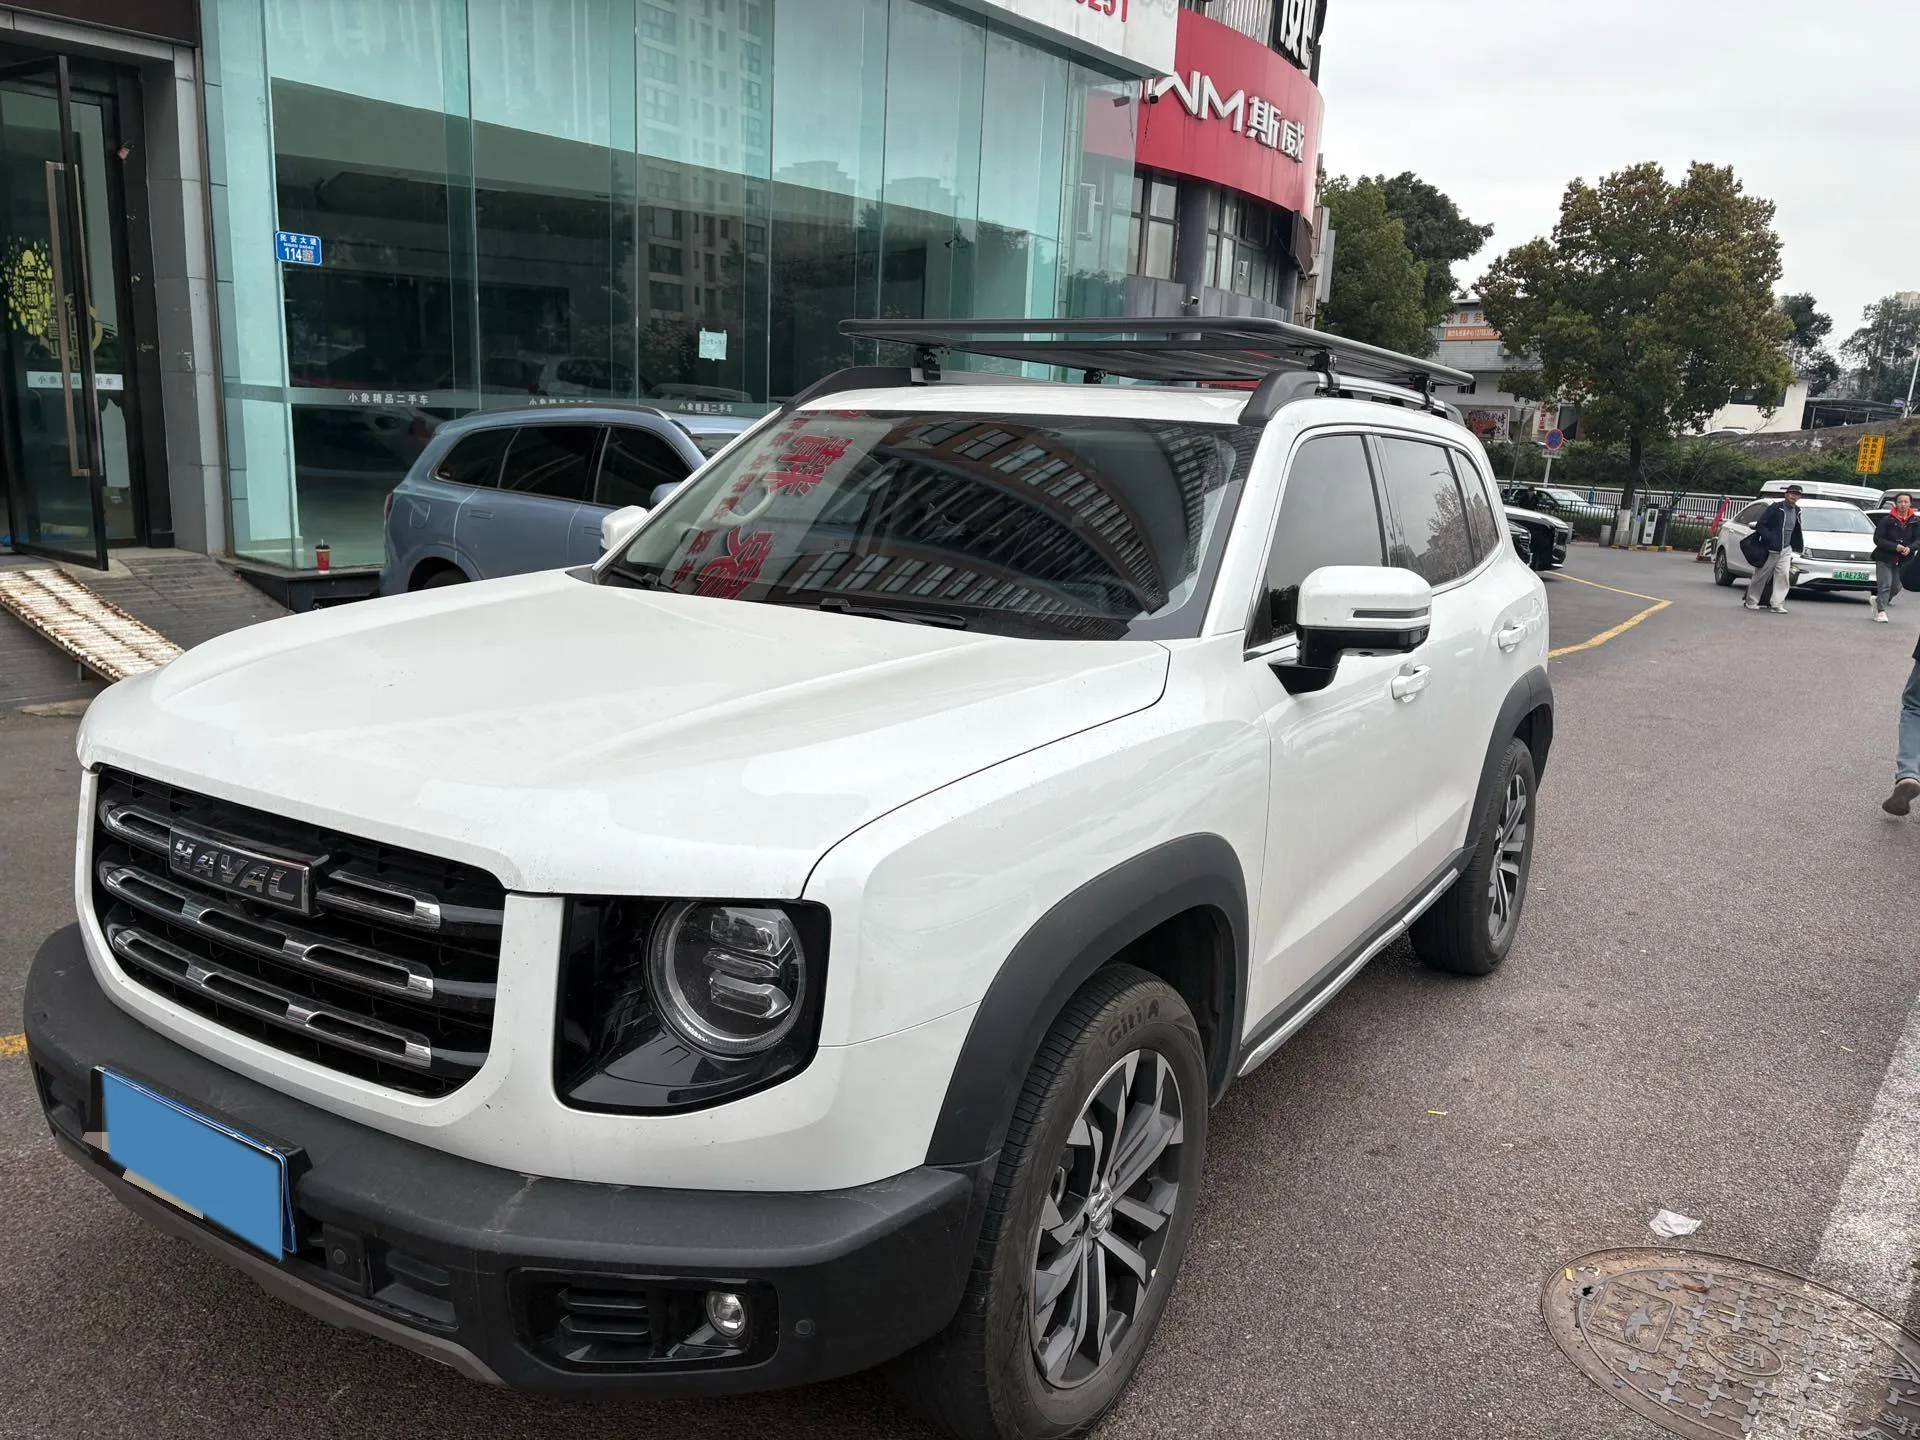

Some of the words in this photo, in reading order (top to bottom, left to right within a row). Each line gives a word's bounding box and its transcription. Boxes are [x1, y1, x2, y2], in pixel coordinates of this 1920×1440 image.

[1246, 95, 1305, 163] 斯威
[284, 247, 302, 261] 114
[348, 391, 429, 405] 小象精品二手车
[174, 838, 296, 901] HAVAL
